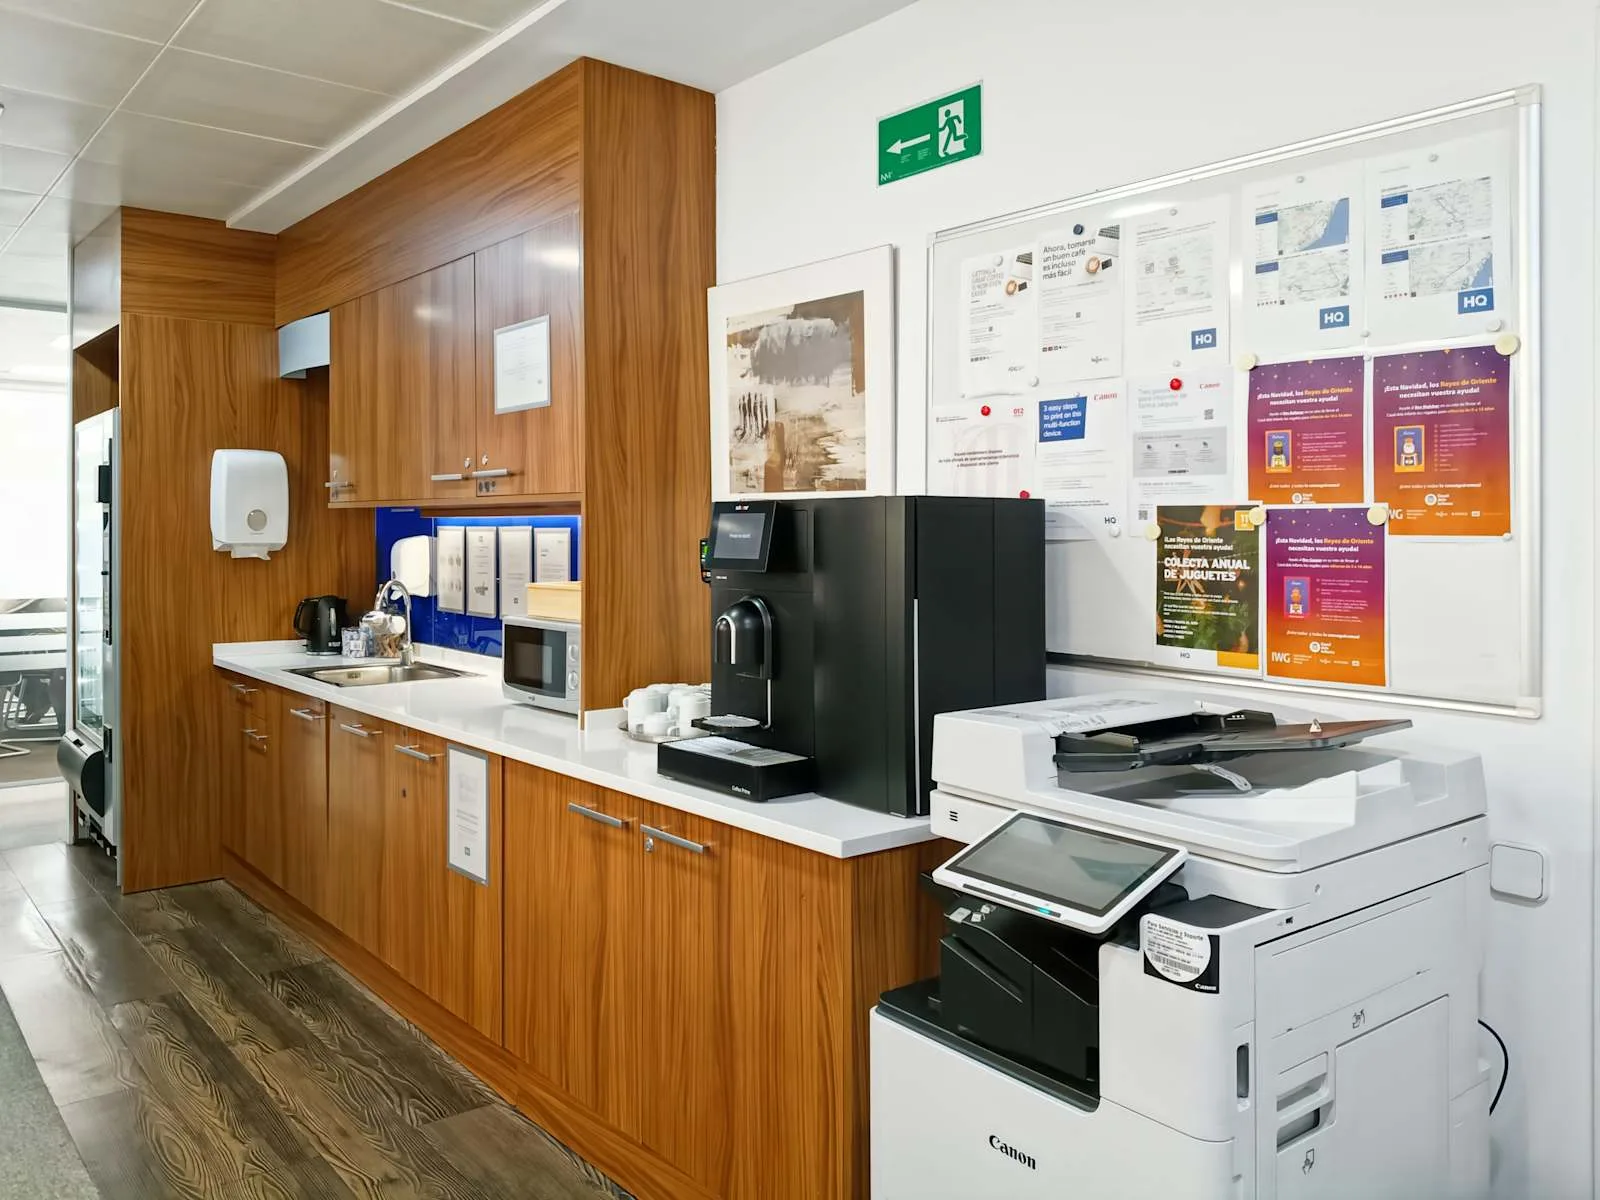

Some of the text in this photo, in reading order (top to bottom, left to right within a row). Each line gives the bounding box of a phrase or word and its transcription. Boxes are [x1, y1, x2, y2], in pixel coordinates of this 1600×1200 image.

[1043, 244, 1067, 255] Ahora,
[1043, 248, 1086, 264] un buen café
[1043, 260, 1076, 272] es incluso
[1042, 271, 1057, 281] más
[1464, 295, 1488, 309] HQ
[1325, 311, 1344, 324] HQ
[1195, 333, 1212, 346] HQ
[1400, 382, 1429, 391] Navidad,
[1440, 380, 1460, 389] Reyes
[1470, 377, 1497, 385] Oriente
[1094, 393, 1117, 401] Canon
[1271, 391, 1295, 399] Navidad,
[1304, 389, 1321, 397] Reyes
[1399, 391, 1430, 400] necesitan
[1431, 389, 1456, 397] vuestra
[1047, 405, 1061, 413] easy
[1062, 403, 1078, 411] steps
[1050, 412, 1063, 421] print
[1043, 419, 1081, 429] multi-function
[1104, 516, 1117, 524] HQ
[1389, 509, 1403, 520] WG
[1289, 537, 1314, 545] Navidad,
[1323, 538, 1341, 546] Reyes
[1163, 556, 1250, 570] COLECTA ANUAL
[1163, 568, 1237, 582] DE JUGUETES
[1271, 651, 1291, 664] IWG
[1147, 920, 1158, 928] Para
[1194, 983, 1217, 991] Canon
[989, 1134, 1036, 1171] Canon
